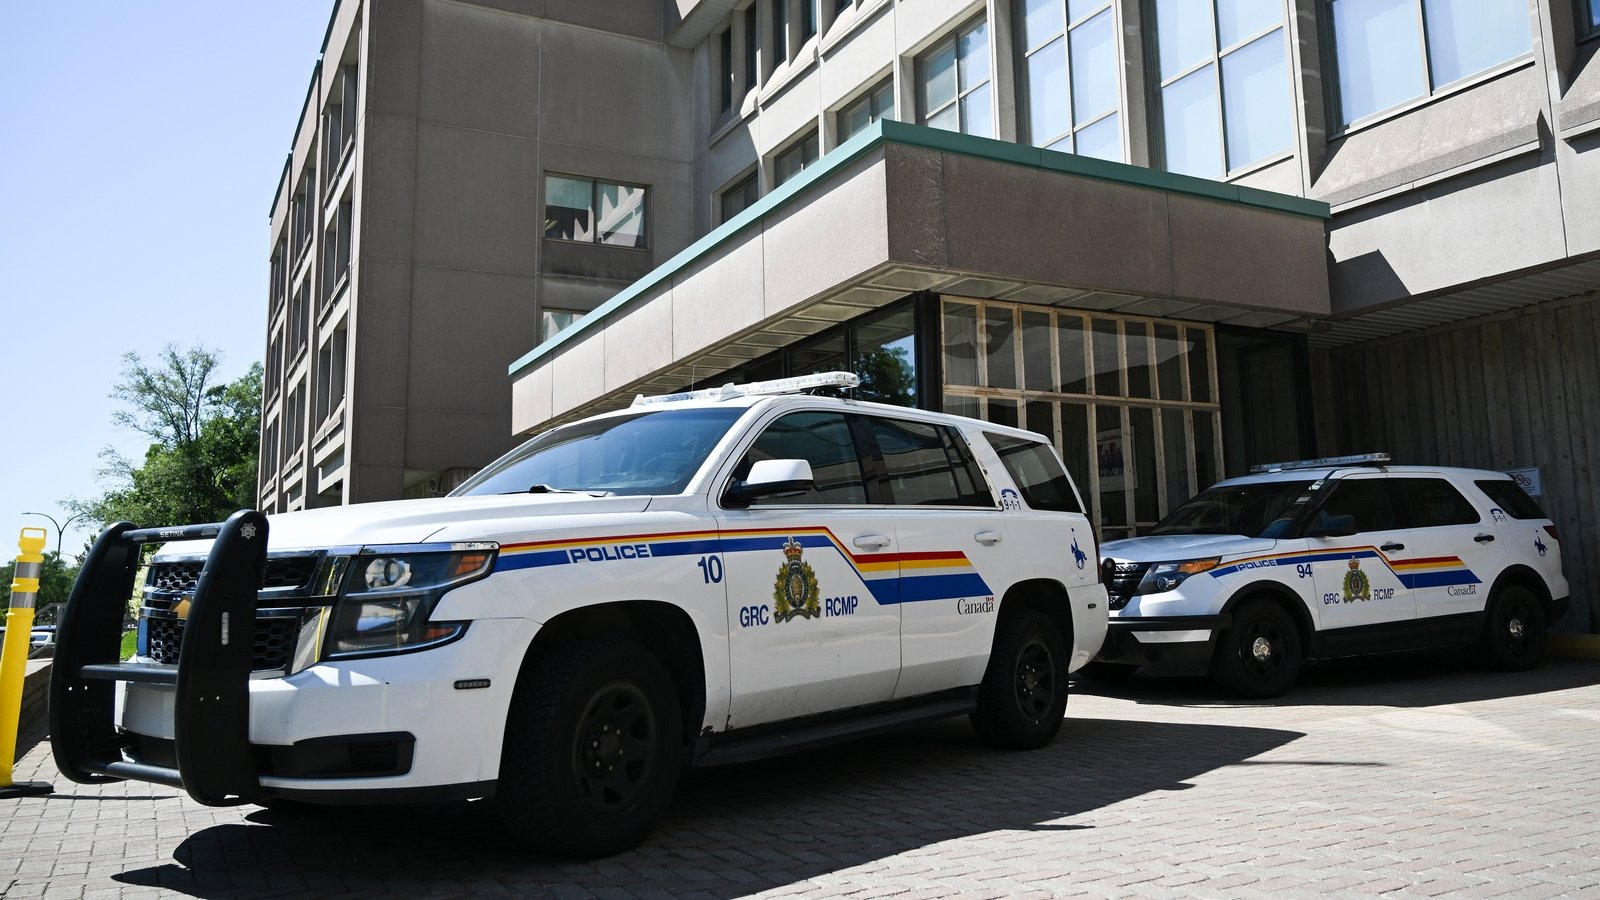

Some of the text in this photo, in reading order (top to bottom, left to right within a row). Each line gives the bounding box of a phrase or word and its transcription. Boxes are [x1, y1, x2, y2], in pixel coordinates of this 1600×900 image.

[571, 544, 651, 564] POLICE
[698, 555, 723, 584] 10
[1239, 560, 1277, 571] POLICE
[1296, 563, 1313, 579] 94
[1323, 588, 1394, 605] GRC RCMP
[1447, 585, 1476, 596] Canada
[740, 595, 858, 627] GRC RCMP
[957, 597, 994, 615] Canada
